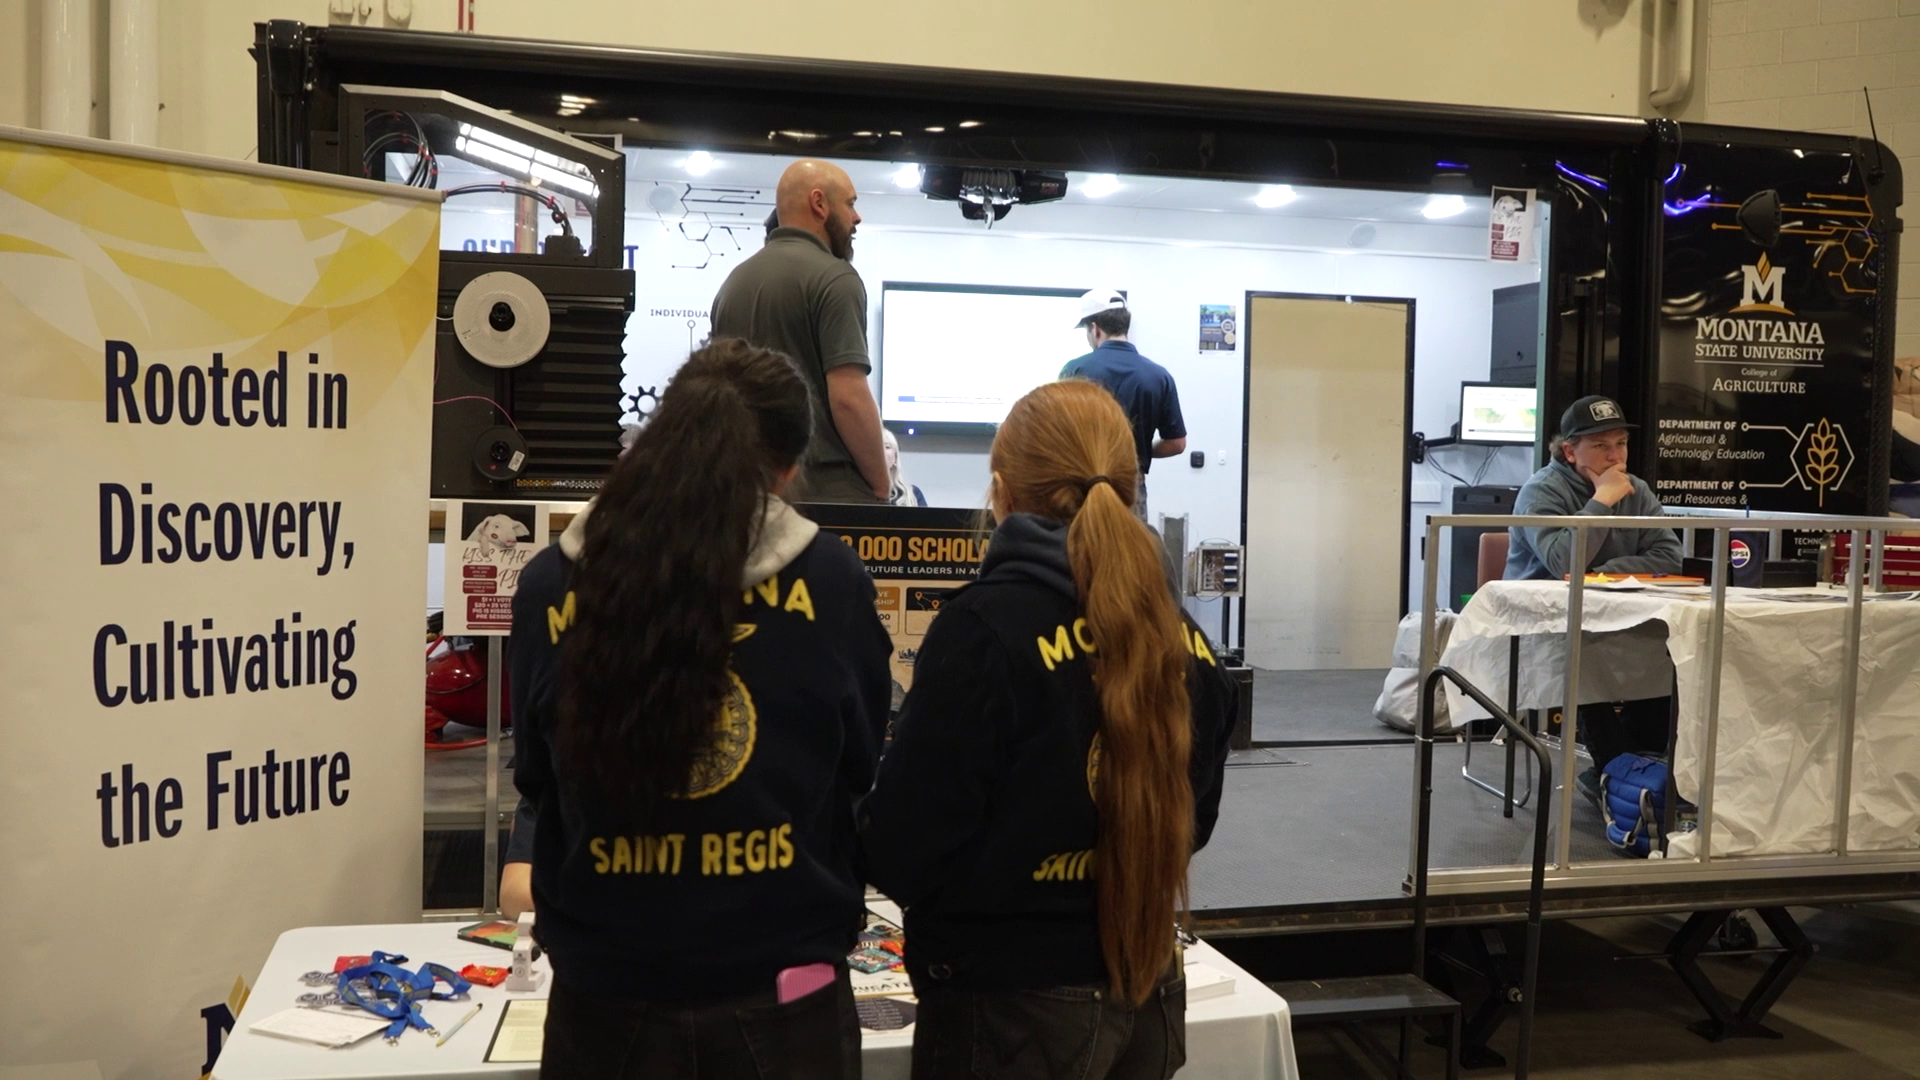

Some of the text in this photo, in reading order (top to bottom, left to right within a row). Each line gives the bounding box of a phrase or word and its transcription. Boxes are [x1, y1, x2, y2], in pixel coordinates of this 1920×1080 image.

[1740, 265, 1786, 308] M
[1694, 317, 1825, 345] MONTANA
[1695, 343, 1825, 361] STATE UNIVERSITY
[1741, 368, 1768, 378] College
[105, 340, 348, 429] Rooted in
[1712, 377, 1806, 394] AGRICULTURE
[1659, 420, 1737, 430] DEPARTMENT OF
[1658, 433, 1727, 446] Agricultural &
[1658, 448, 1765, 461] Technology Education
[1657, 480, 1734, 490] DEPARTMENT OF
[1656, 494, 1748, 505] Land Resources &
[99, 482, 354, 577] Discovery,
[462, 547, 495, 564] KISS
[864, 566, 904, 574] FUTURE
[907, 567, 953, 575] LEADERS
[955, 567, 967, 575] IN
[93, 611, 358, 708] Cultivating
[96, 749, 351, 849] the Future
[589, 822, 795, 876] SAINT REGIS
